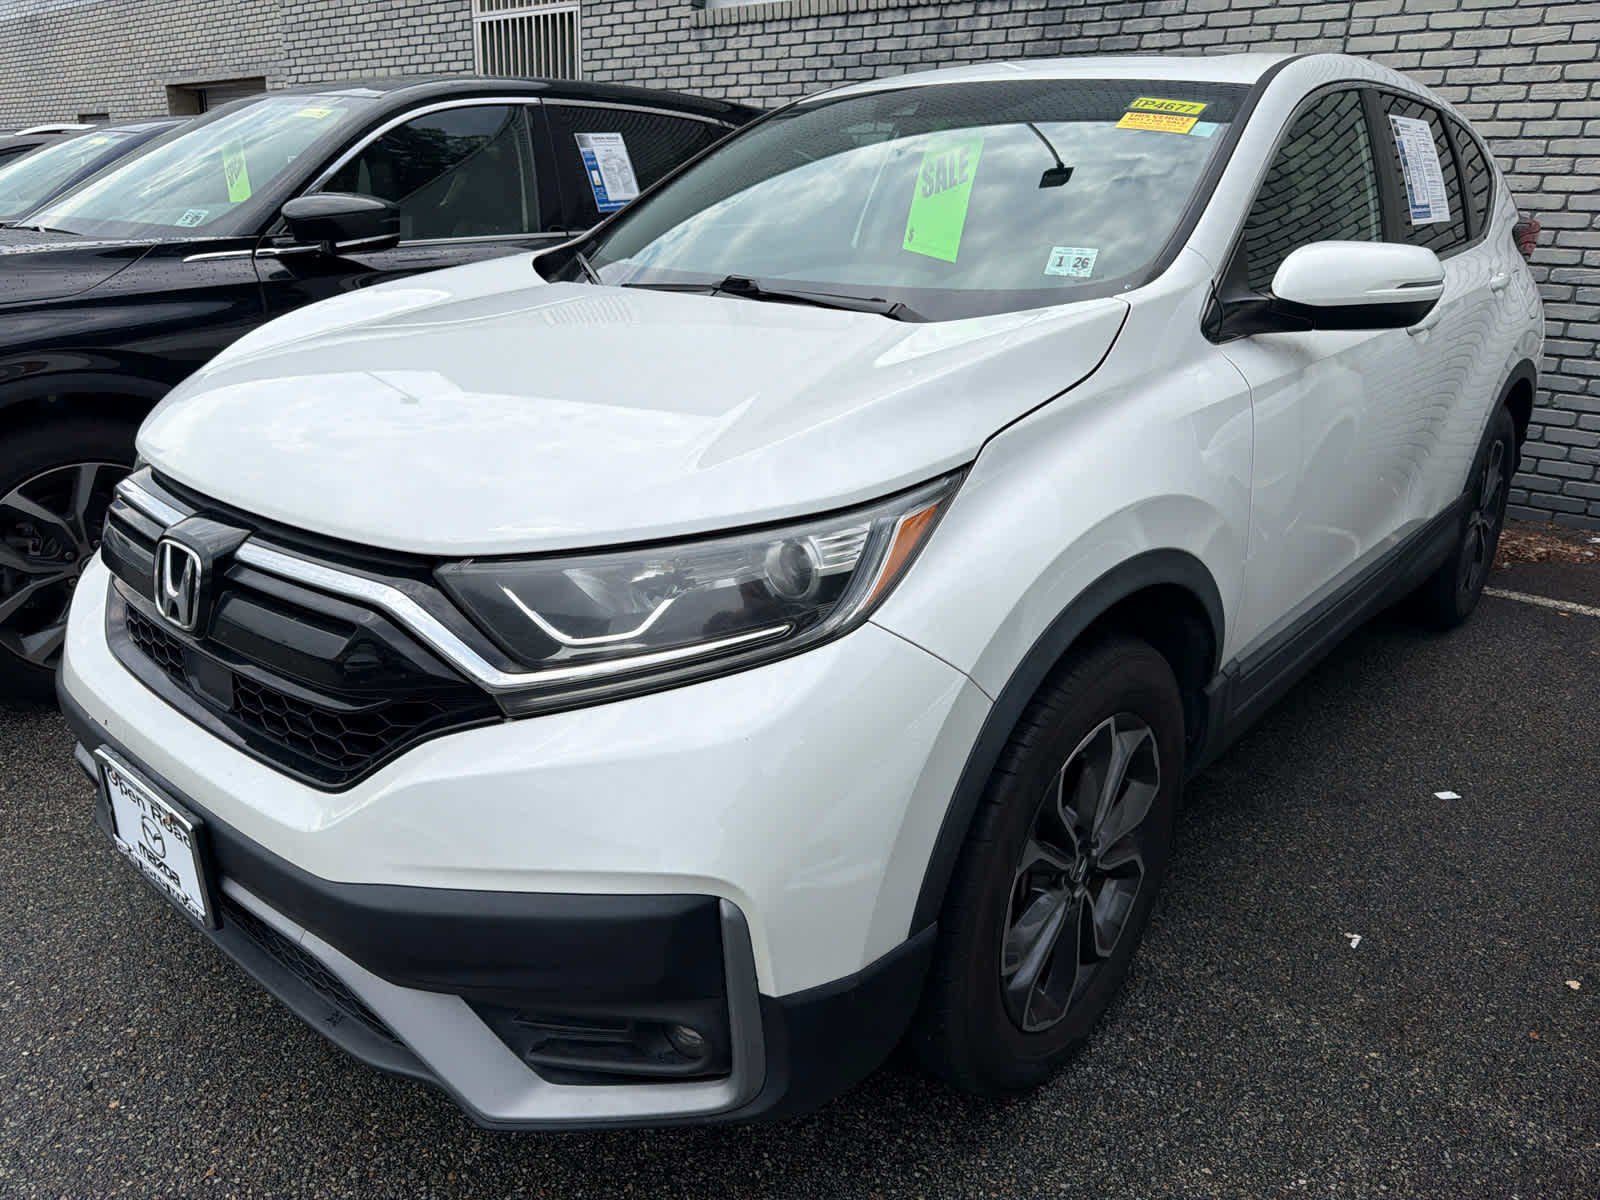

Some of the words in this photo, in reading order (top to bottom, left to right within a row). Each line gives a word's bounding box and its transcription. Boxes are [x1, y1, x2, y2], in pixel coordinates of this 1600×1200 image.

[922, 146, 970, 198] SALE
[1056, 256, 1065, 267] 1
[1072, 256, 1090, 269] 26
[107, 767, 146, 811] Open
